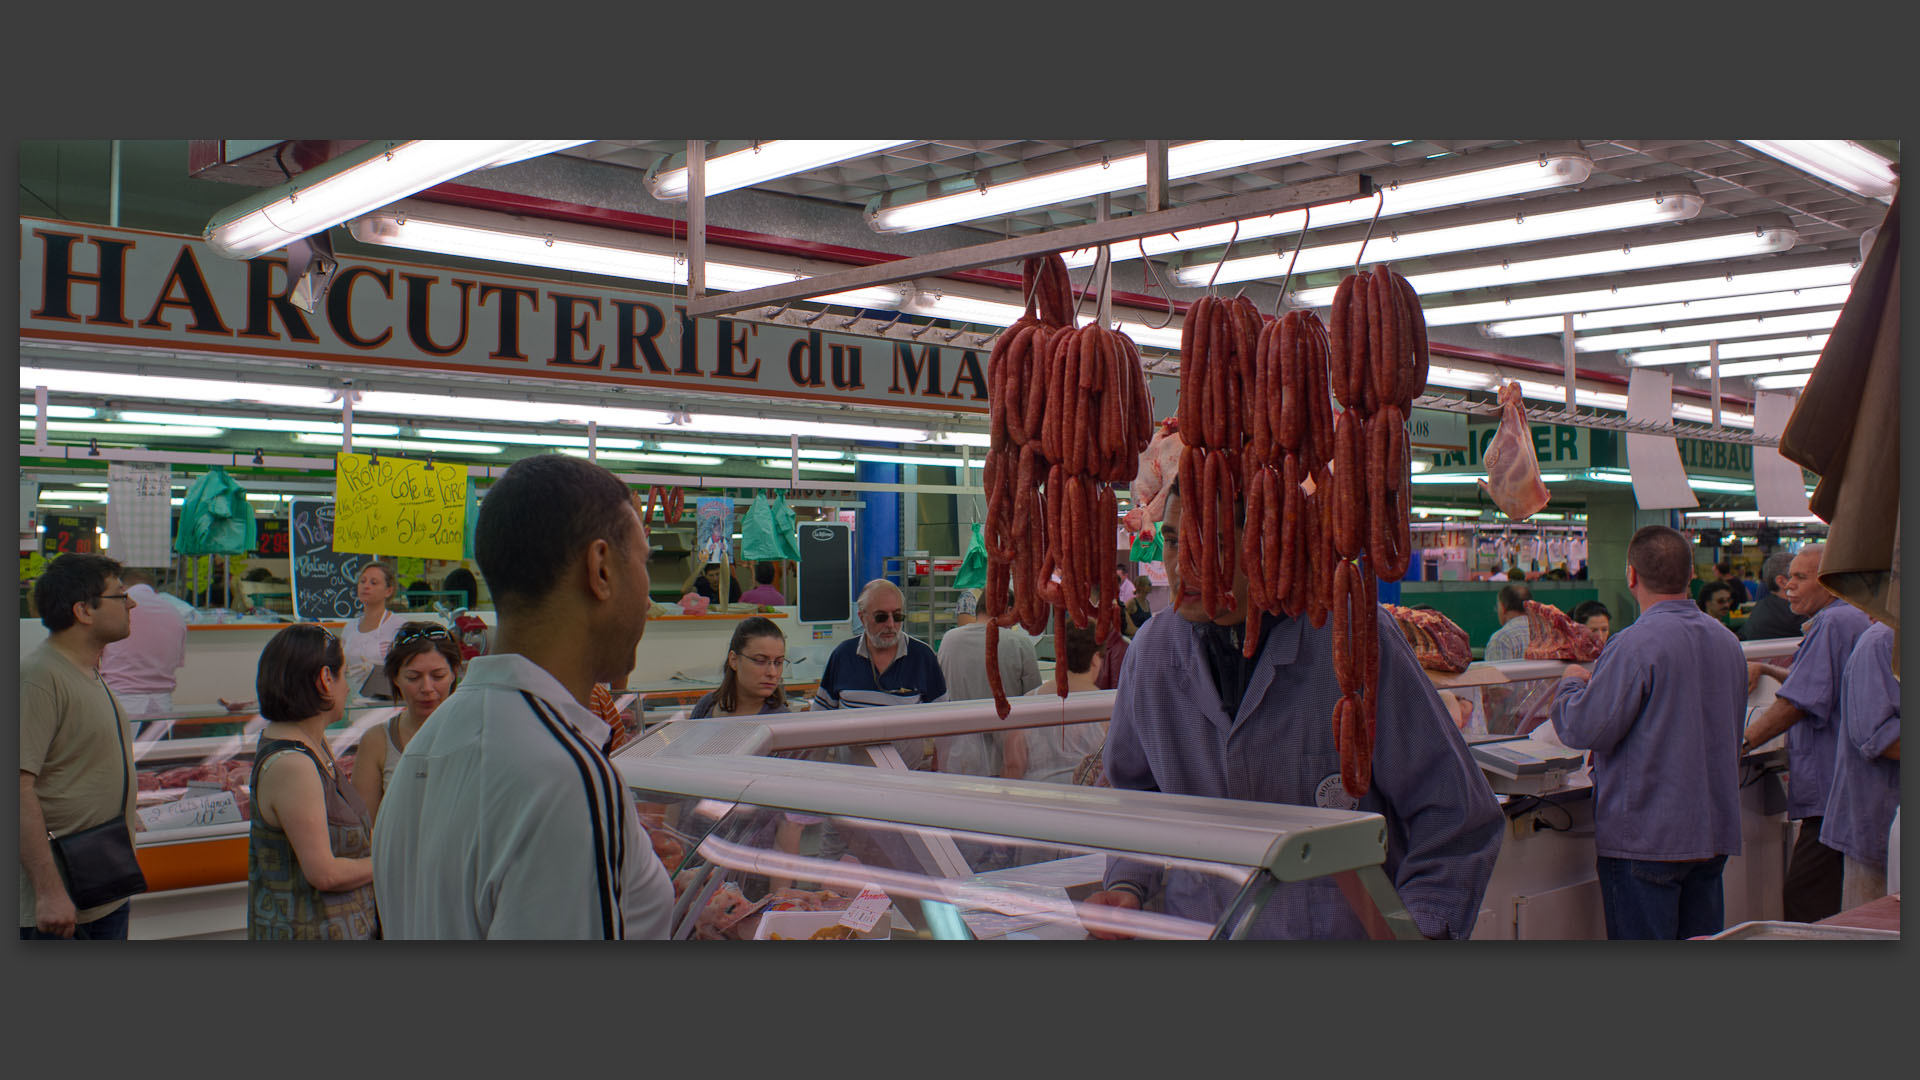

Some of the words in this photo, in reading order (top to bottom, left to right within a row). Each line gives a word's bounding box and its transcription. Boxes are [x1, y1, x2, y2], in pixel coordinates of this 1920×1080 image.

[20, 226, 760, 384] HARCUTERIE
[788, 333, 864, 392] du
[889, 342, 989, 401] MA
